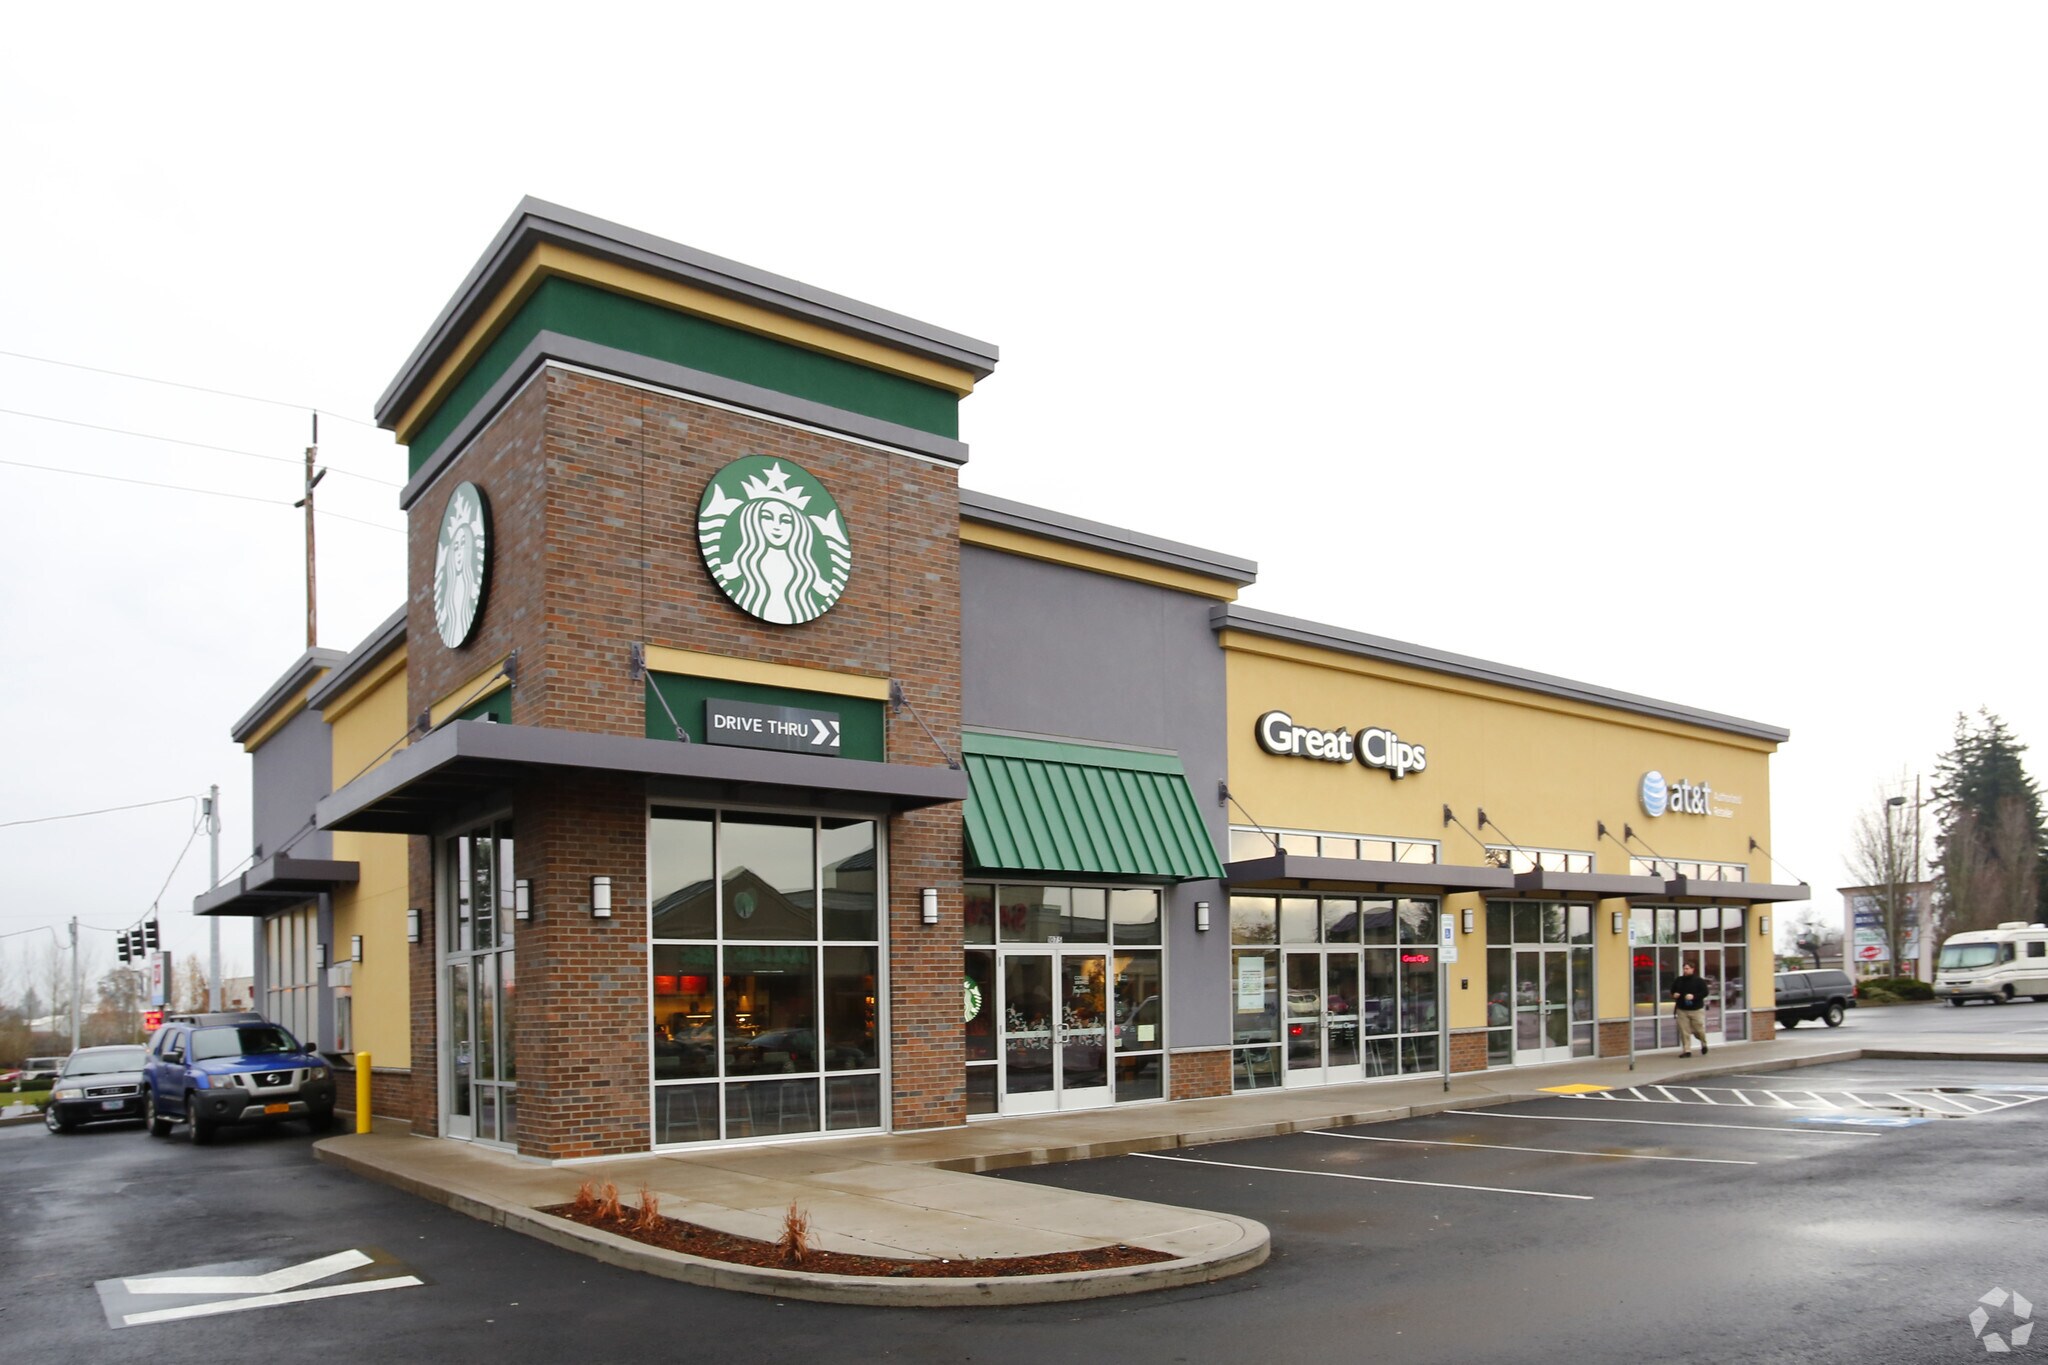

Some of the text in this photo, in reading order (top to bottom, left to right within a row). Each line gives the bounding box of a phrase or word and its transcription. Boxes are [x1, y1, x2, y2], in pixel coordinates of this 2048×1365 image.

[714, 714, 809, 737] DRIVE THRU
[1260, 710, 1427, 778] Great Clips
[1671, 778, 1712, 815] at&t
